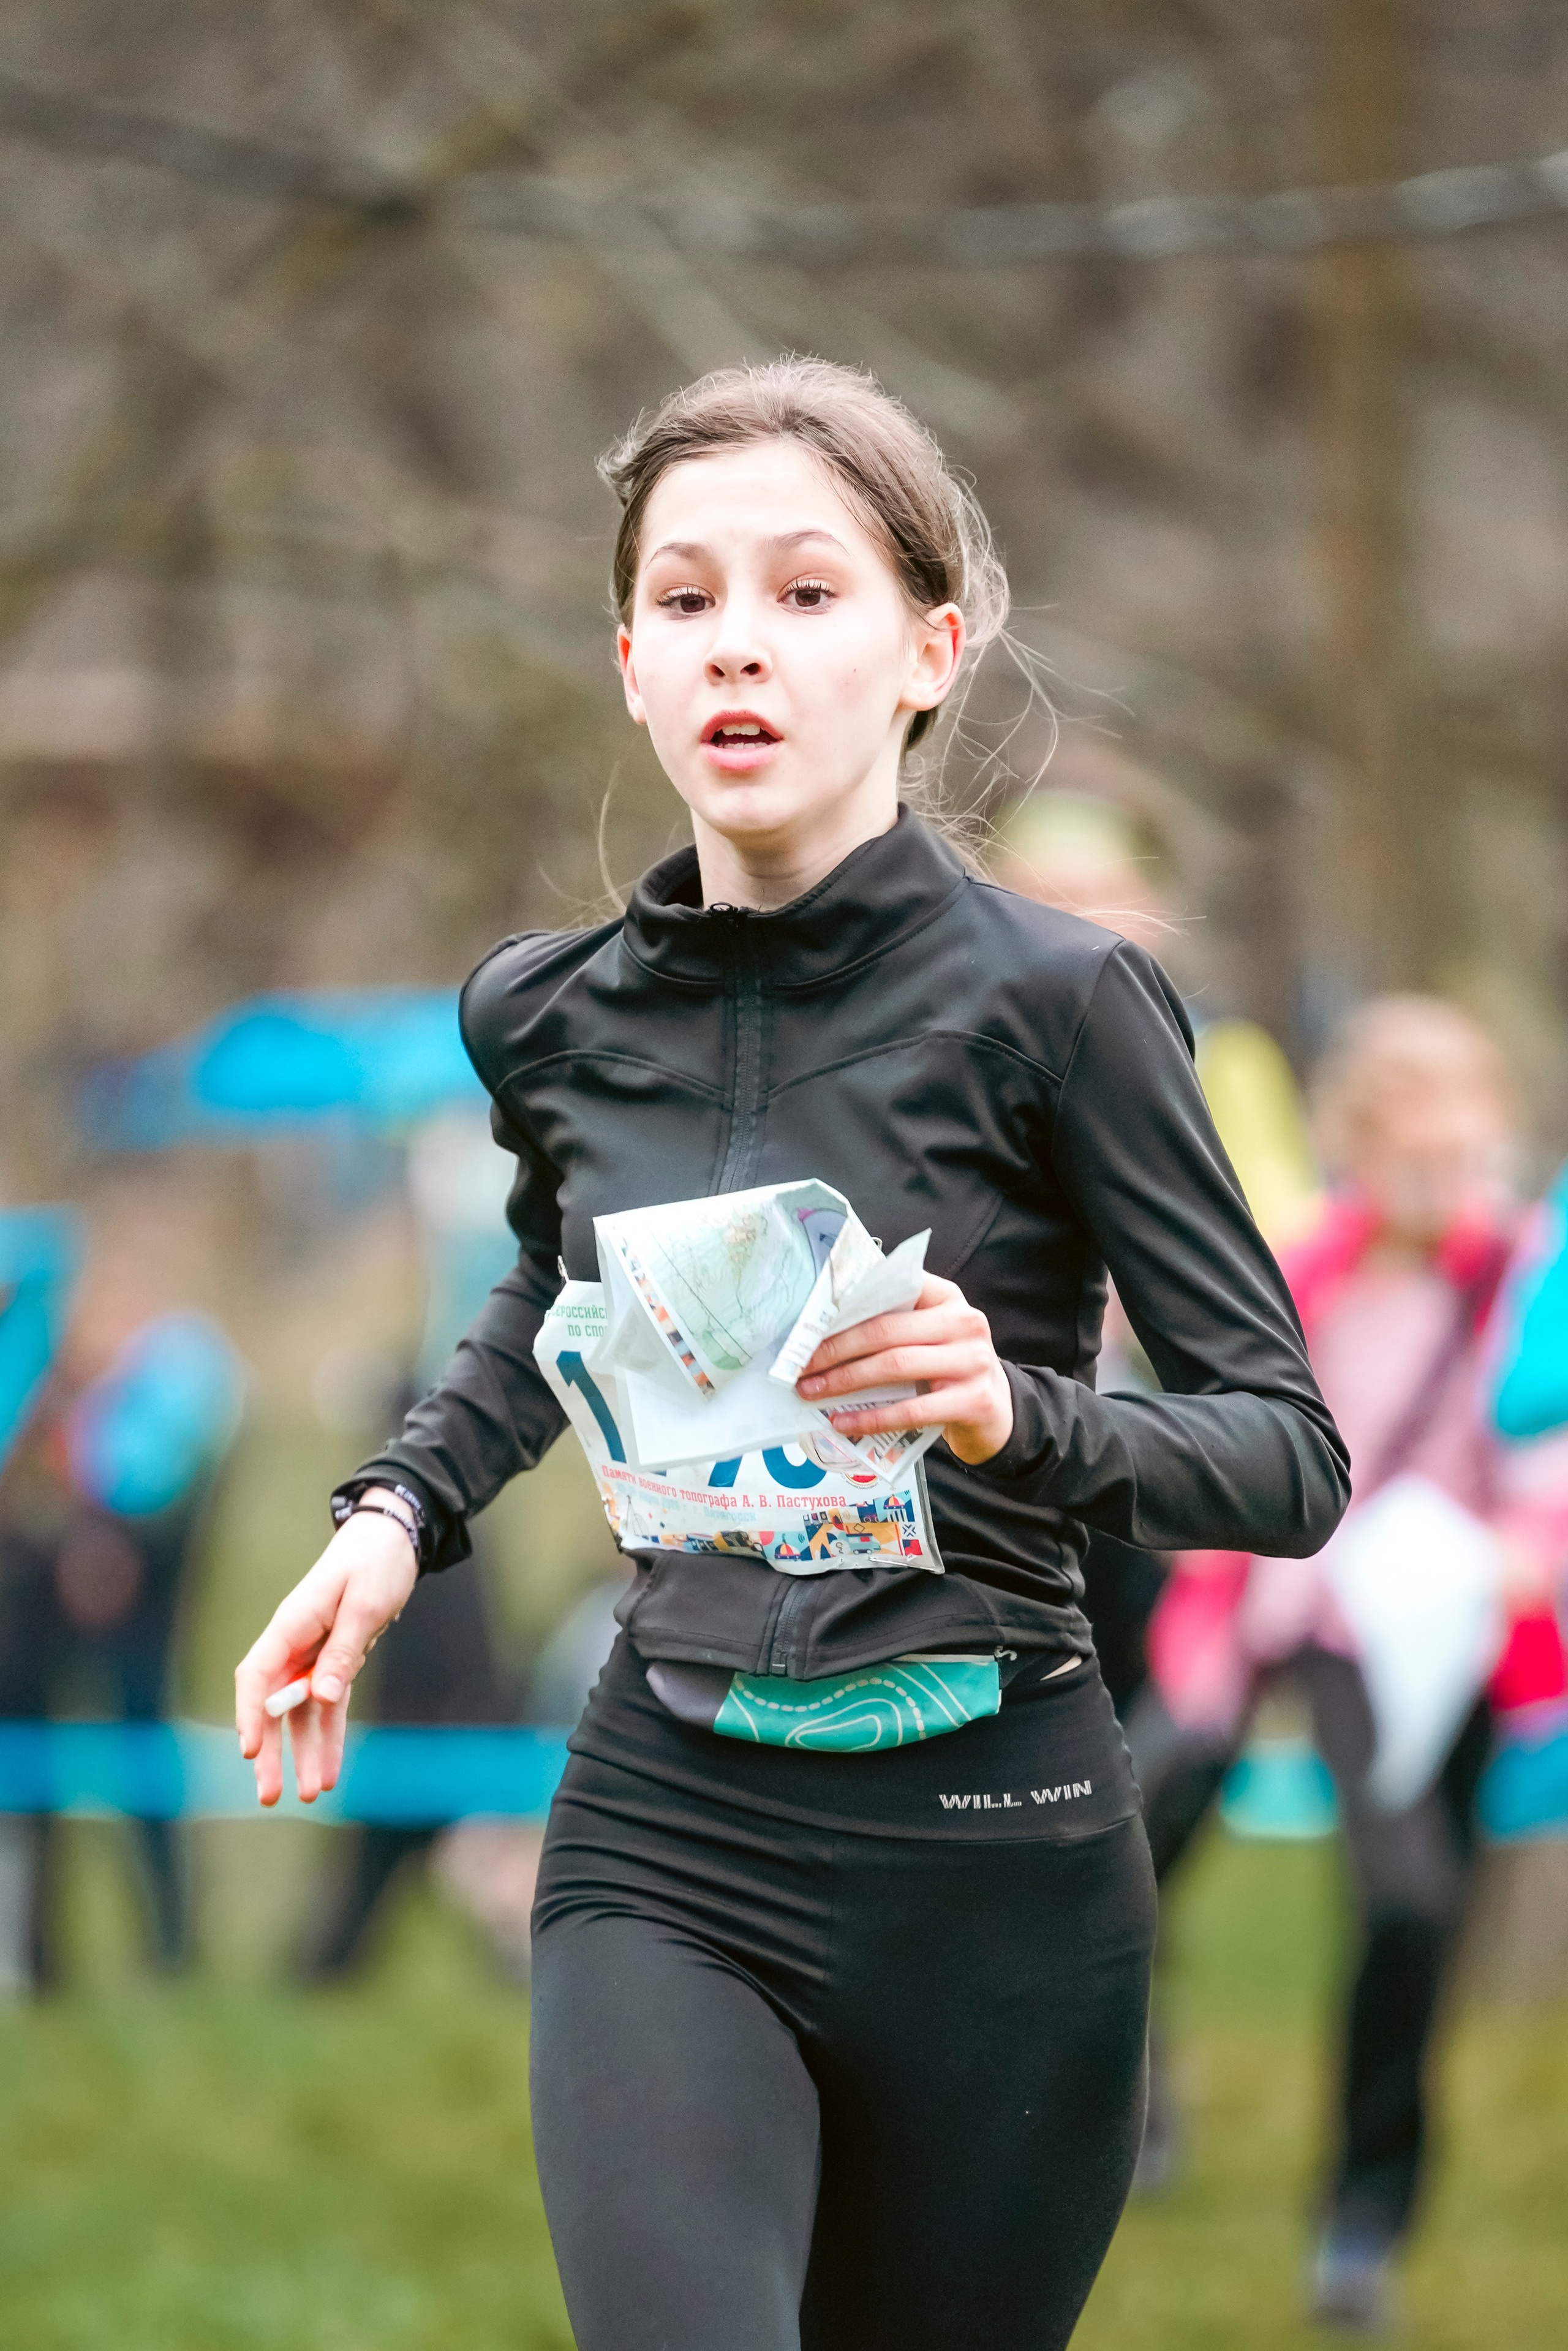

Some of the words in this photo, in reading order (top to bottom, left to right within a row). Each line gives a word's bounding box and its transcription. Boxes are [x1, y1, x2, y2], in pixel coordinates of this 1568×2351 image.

[551, 1304, 608, 1319] СЕРОССИЙС
[567, 1324, 582, 1336] ПО
[585, 1325, 608, 1337] СПО
[601, 1465, 636, 1485] Памяти
[638, 1475, 677, 1498] военного
[679, 1490, 737, 1510] топографа
[742, 1495, 754, 1508] А.
[758, 1495, 772, 1508] В.
[776, 1495, 847, 1511] Пастухова
[939, 1793, 1022, 1809] WILL
[1030, 1780, 1091, 1805] WIN
